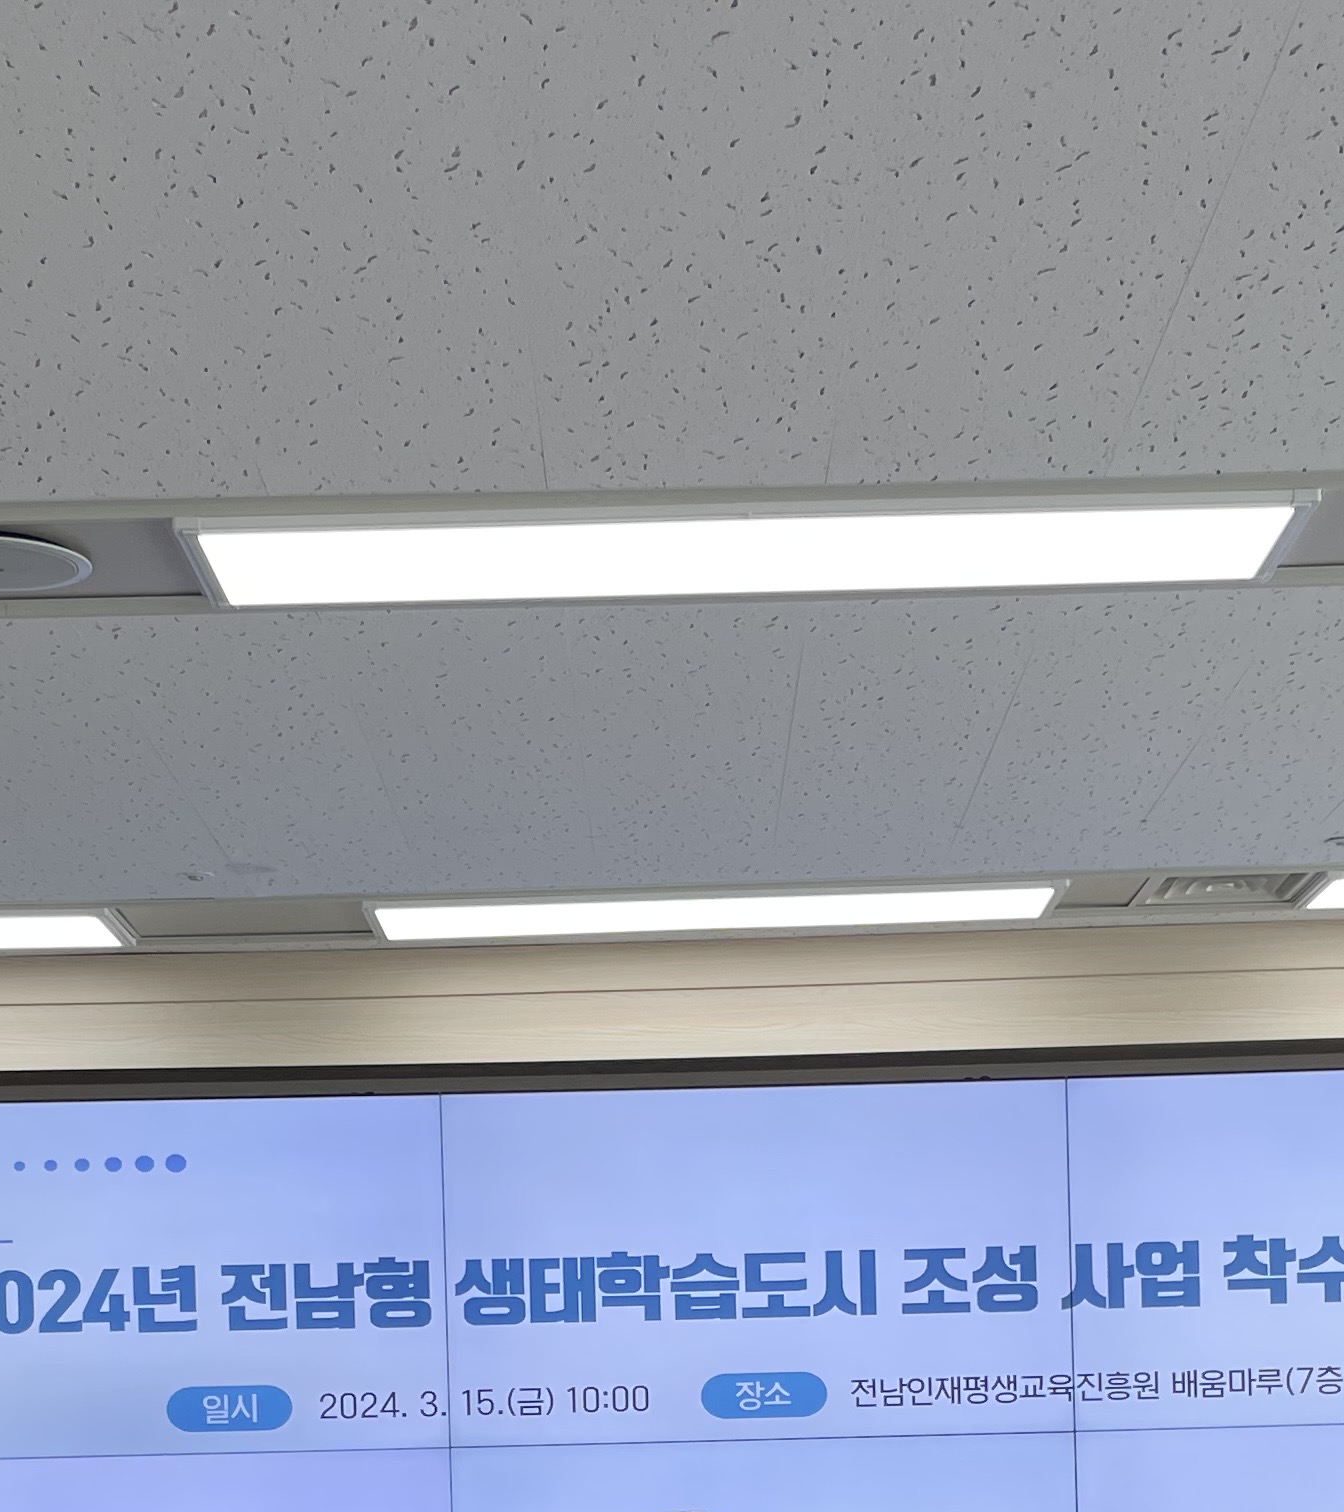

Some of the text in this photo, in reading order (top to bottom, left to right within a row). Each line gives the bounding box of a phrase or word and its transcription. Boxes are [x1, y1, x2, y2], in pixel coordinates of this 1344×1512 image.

[221, 1257, 431, 1331] 전남형
[455, 1249, 877, 1326] 생태학습도시
[902, 1245, 1038, 1314] 조성
[1061, 1239, 1201, 1310] 사업
[320, 1386, 649, 1419] 2024. 3. 15.(금) 10:00
[735, 1380, 792, 1410] 장소
[850, 1374, 1160, 1406] 전남인재평생교육진흥원
[202, 1394, 258, 1424] 일시
